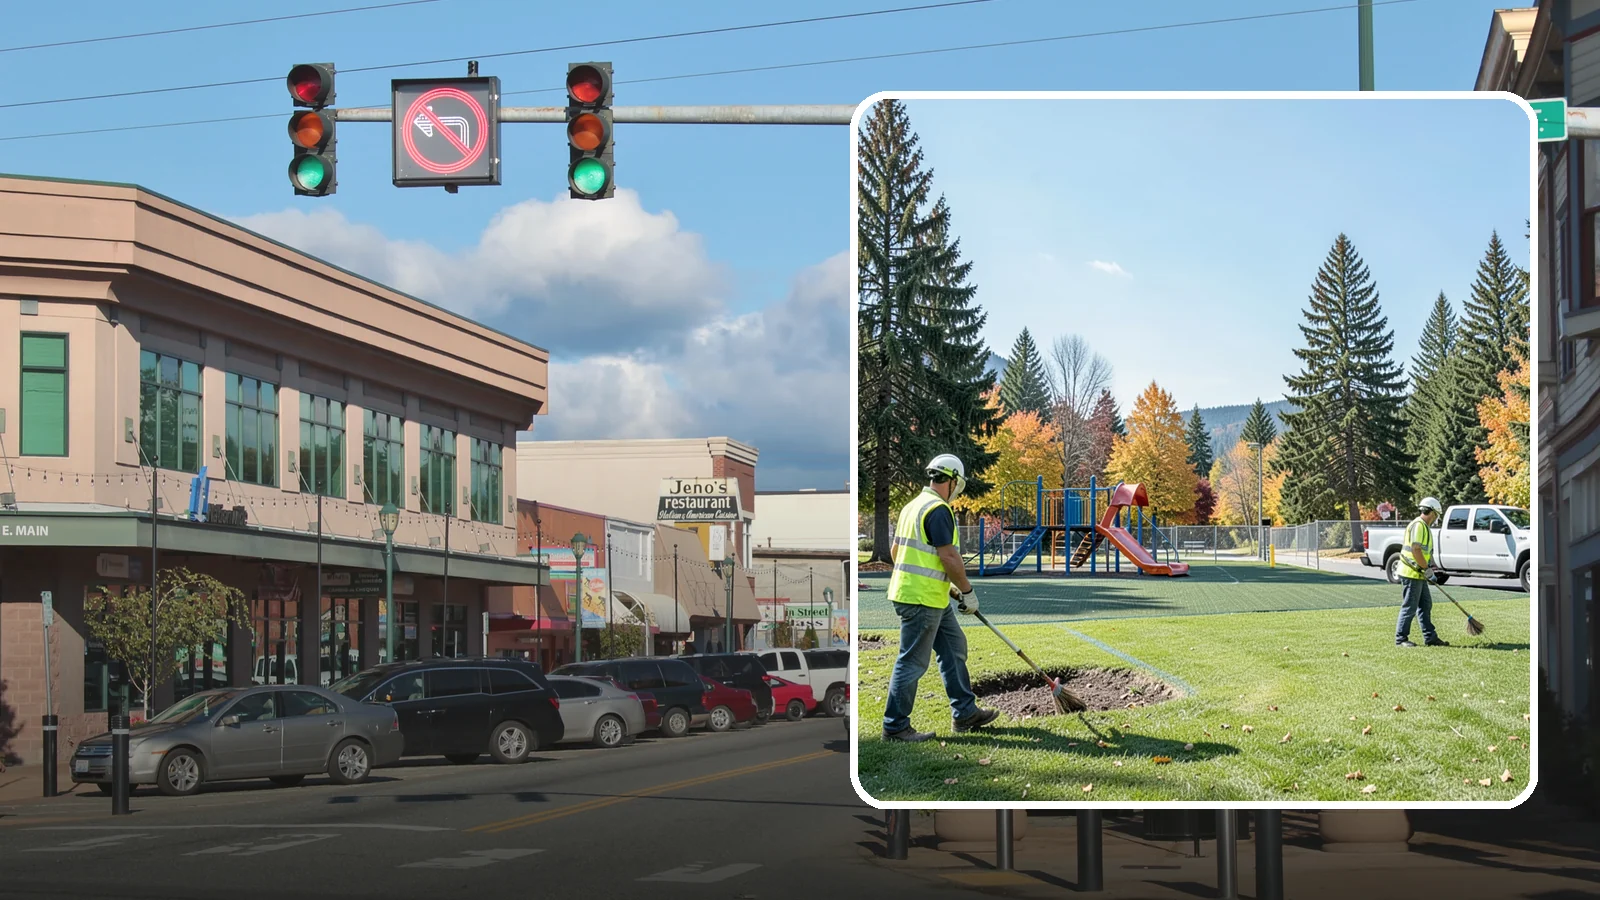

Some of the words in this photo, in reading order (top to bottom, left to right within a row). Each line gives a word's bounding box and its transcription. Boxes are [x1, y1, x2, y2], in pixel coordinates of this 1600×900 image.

[670, 480, 727, 494] Jeno's
[665, 497, 730, 509] restaurant
[686, 509, 714, 520] American
[715, 509, 738, 519] Cuisine
[2, 525, 13, 536] E.
[15, 525, 49, 536] MAIN
[797, 608, 828, 617] Street
[791, 619, 823, 627] lass
